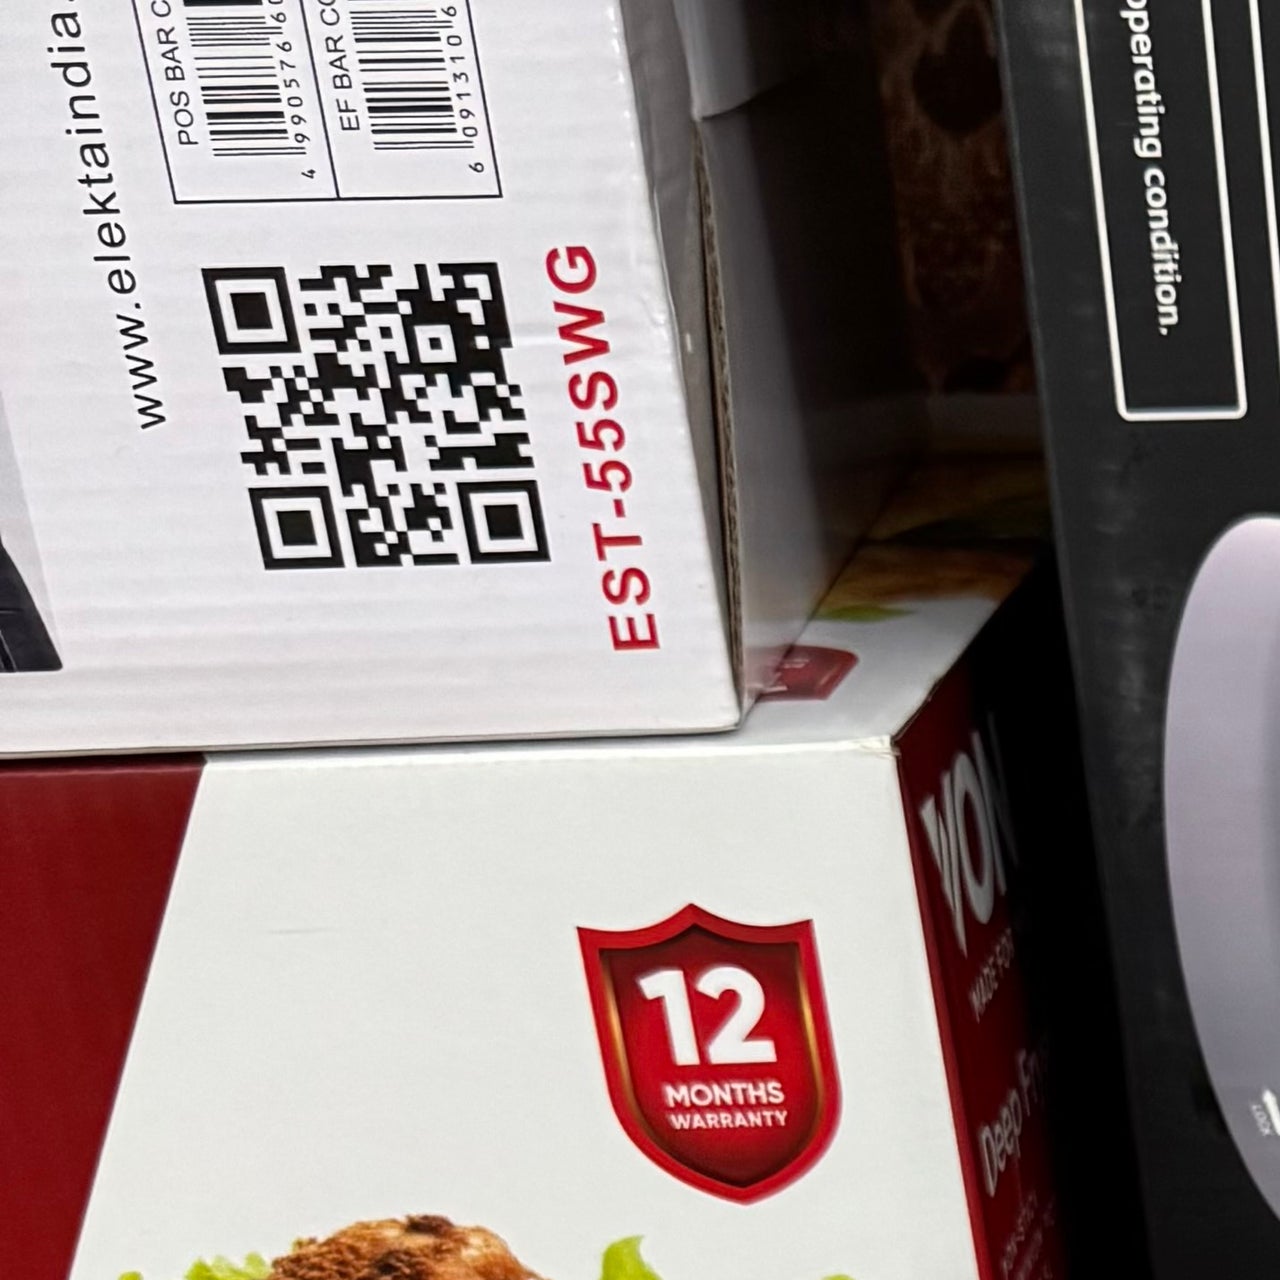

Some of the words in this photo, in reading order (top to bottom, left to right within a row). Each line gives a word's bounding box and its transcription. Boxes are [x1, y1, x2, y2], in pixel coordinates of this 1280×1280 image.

[157, 27, 187, 81] BAR
[325, 34, 352, 89] BAR
[170, 91, 199, 145] POS
[338, 100, 360, 132] EF
[1143, 167, 1182, 336] condition.
[546, 245, 660, 650] EST-55SWG
[640, 966, 777, 1066] 12
[664, 1080, 785, 1108] MONTHS
[669, 1110, 788, 1130] WARRANTY
[977, 1086, 1024, 1199] Deep
